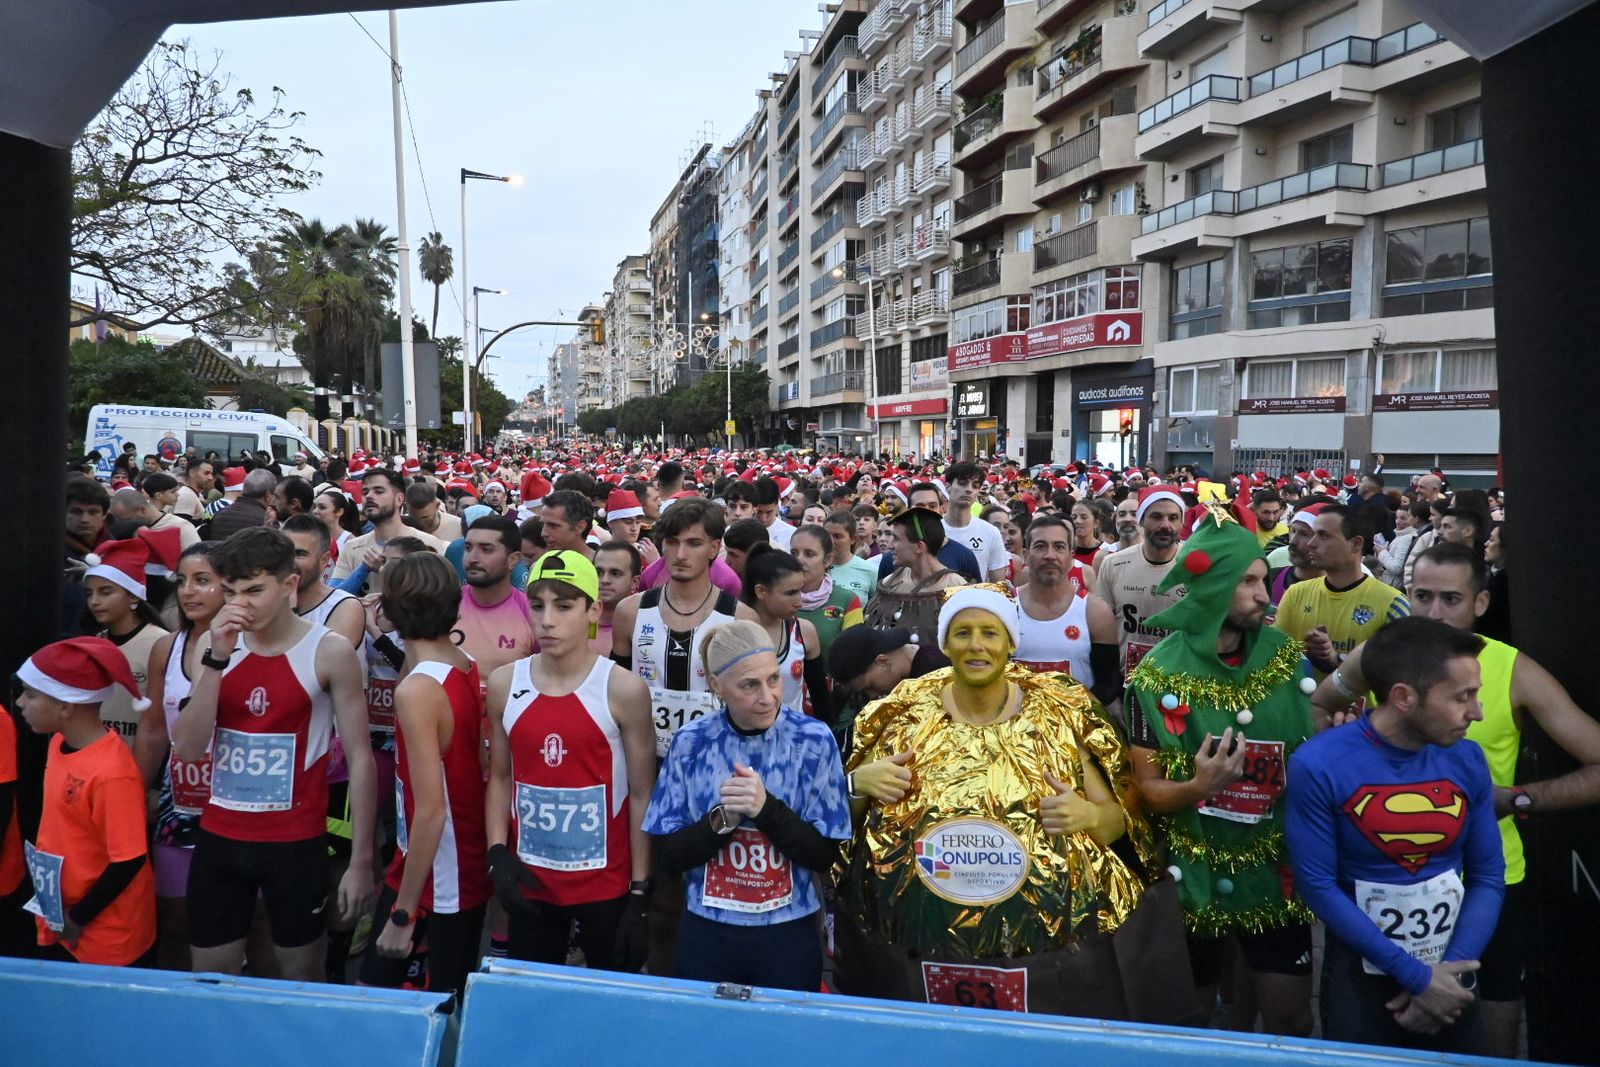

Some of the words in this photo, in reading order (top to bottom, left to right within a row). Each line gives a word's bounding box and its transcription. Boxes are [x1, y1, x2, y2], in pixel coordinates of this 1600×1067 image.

[1088, 322, 1095, 331] TU
[1063, 332, 1095, 346] PROPIEDAD
[956, 342, 985, 357] ABOGADOS
[895, 404, 912, 413] MAPFRE
[218, 413, 258, 422] CIVIL
[216, 744, 289, 776] 2652
[1223, 790, 1250, 799] ESTEVEZ
[520, 800, 600, 833] 2573
[942, 834, 1005, 849] FERRERO
[942, 851, 1022, 865] ONUPOLIS
[725, 876, 747, 886] MARTIN
[747, 880, 774, 888] POSTIGO
[1380, 902, 1451, 941] 232
[955, 980, 998, 1010] 63
